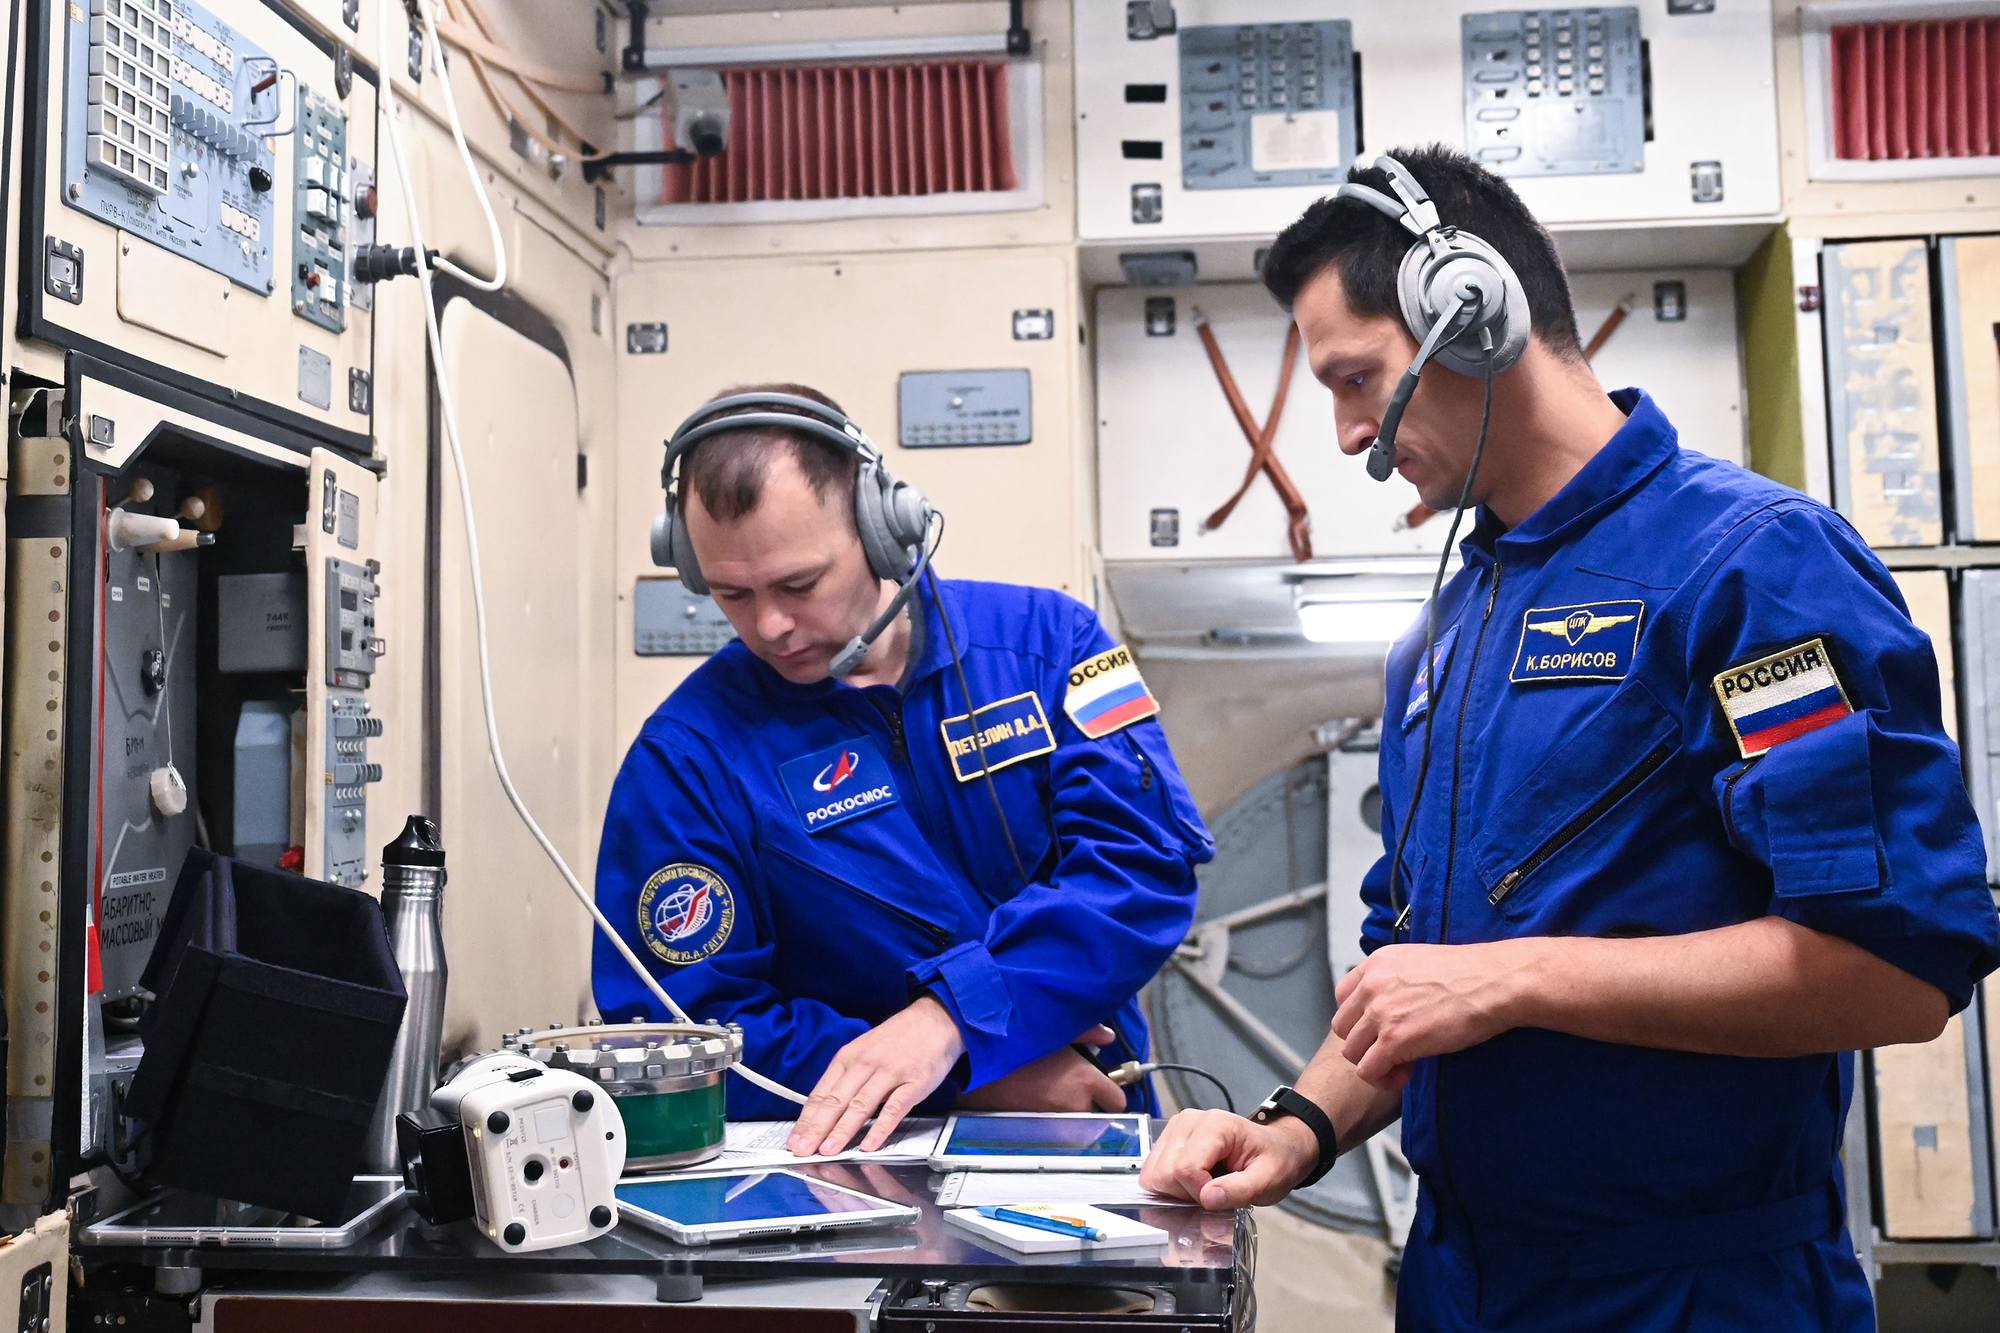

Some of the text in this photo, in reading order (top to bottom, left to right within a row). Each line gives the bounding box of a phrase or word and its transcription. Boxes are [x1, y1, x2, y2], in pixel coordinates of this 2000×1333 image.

[1569, 616, 1588, 629] ЦПК
[1069, 651, 1130, 686] ОССИЯ
[1526, 652, 1617, 671] К.БОРИСОВ
[1722, 648, 1822, 699] РОССИЯ
[806, 785, 892, 824] РОСКОСМОС
[102, 891, 156, 921] ГАБАРИТНО-
[101, 912, 153, 949] МАССОВЫЙ
